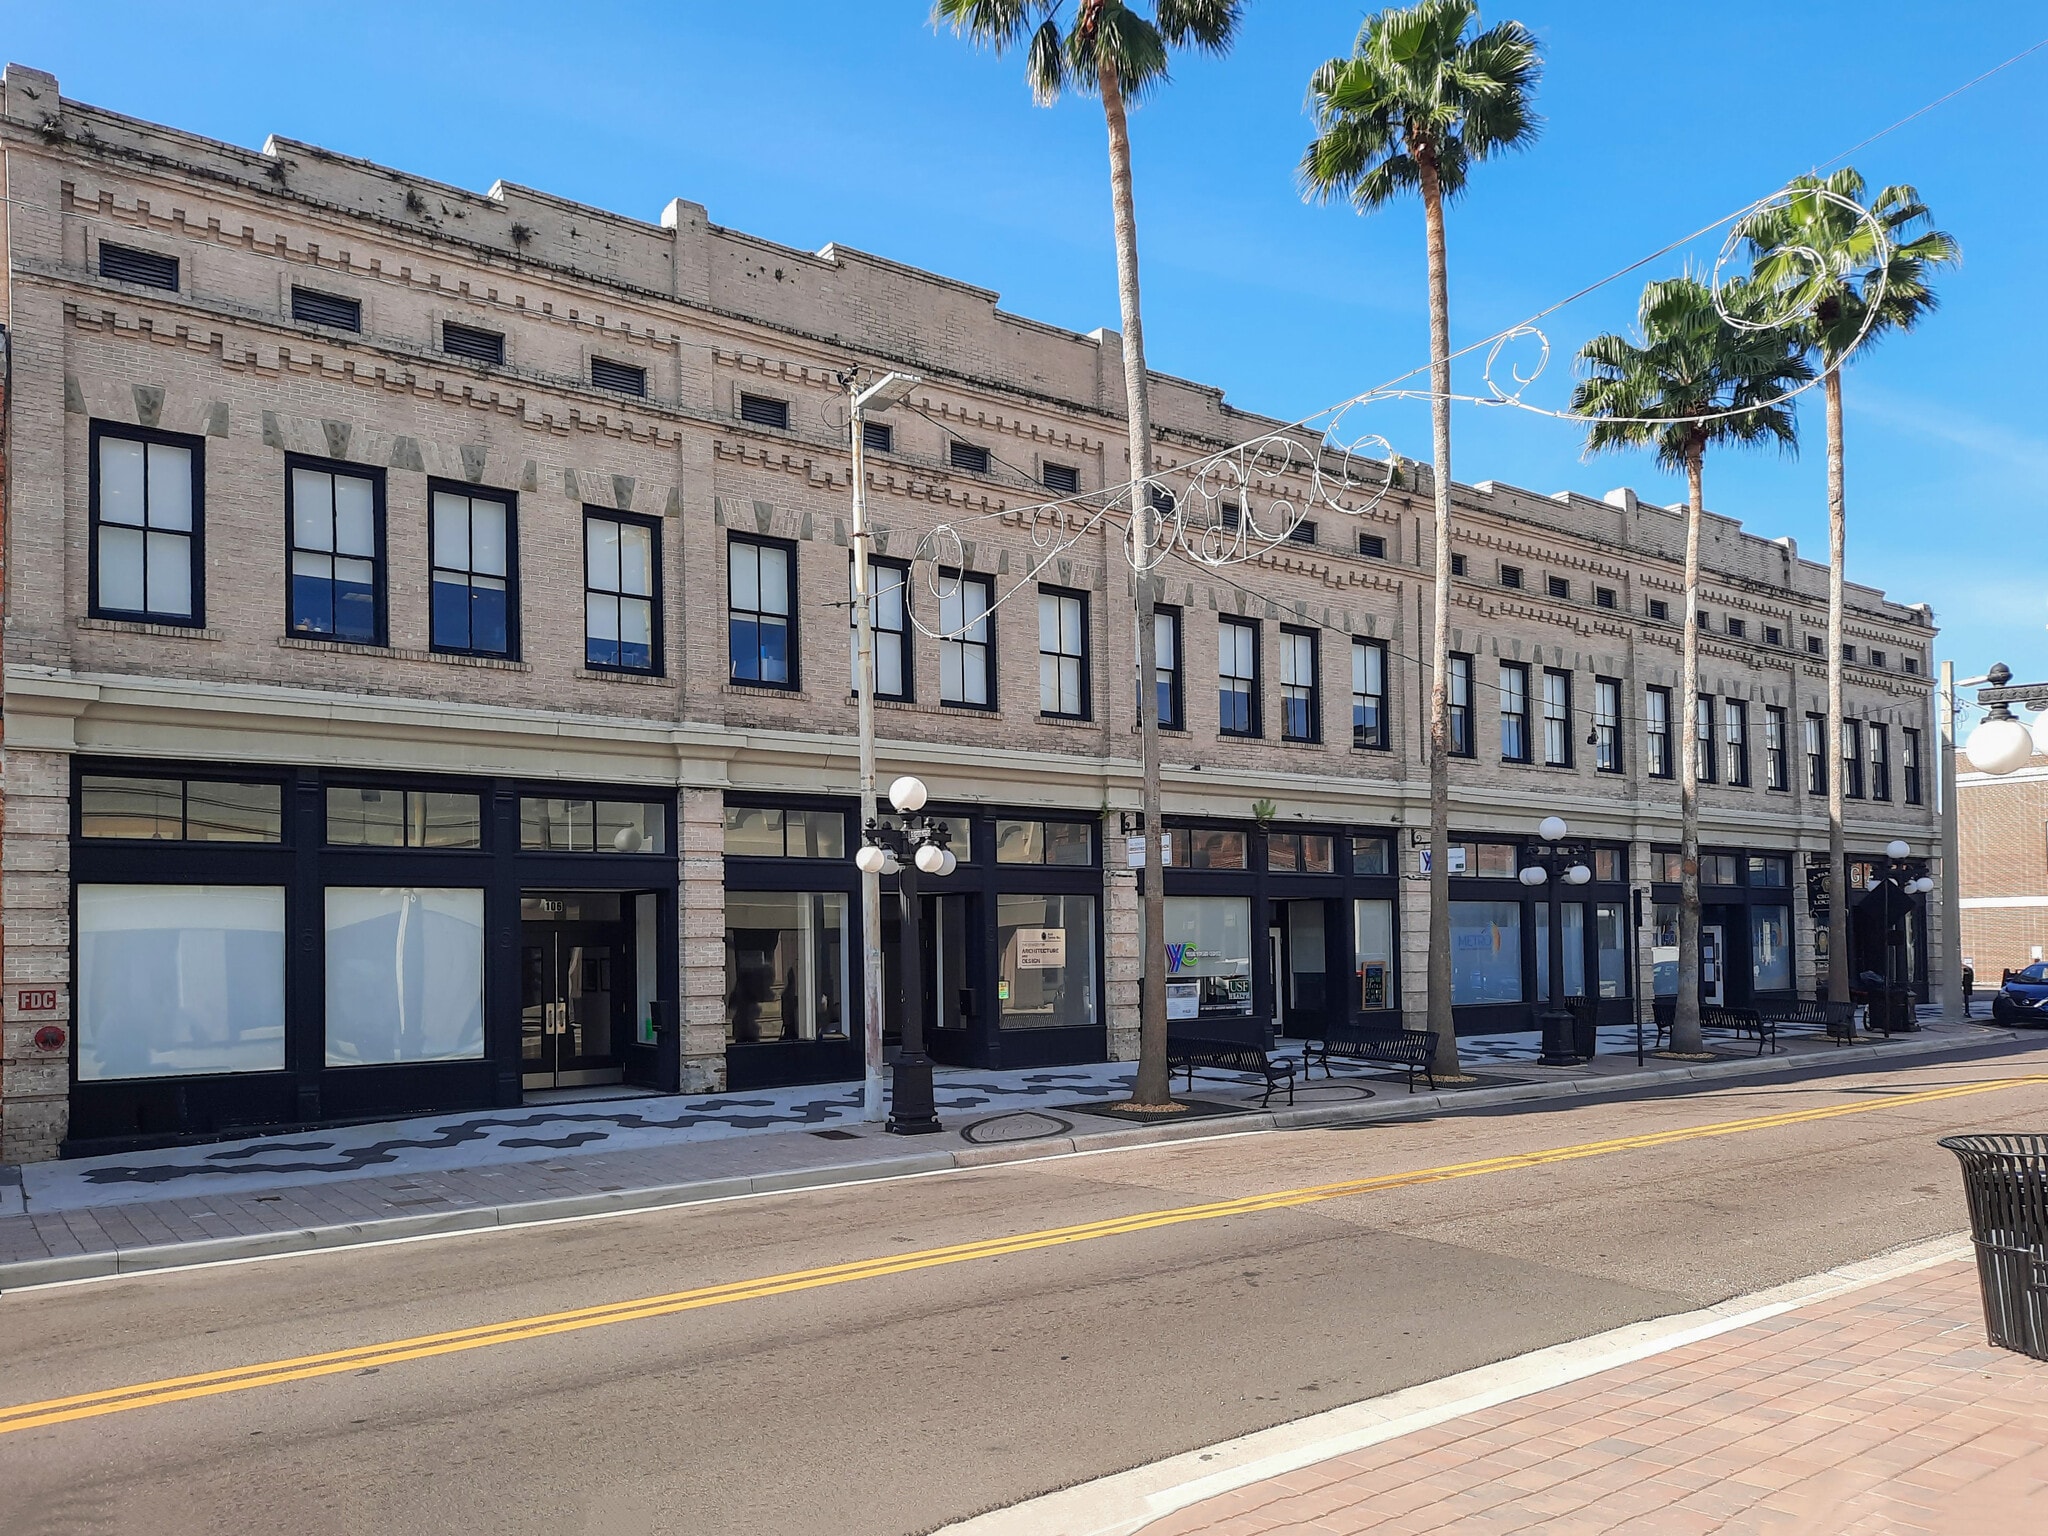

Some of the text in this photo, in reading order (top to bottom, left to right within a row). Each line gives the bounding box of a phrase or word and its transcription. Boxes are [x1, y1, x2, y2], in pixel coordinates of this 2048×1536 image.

[546, 901, 562, 911] 106
[1229, 981, 1248, 992] USF
[21, 992, 54, 1009] FDC
